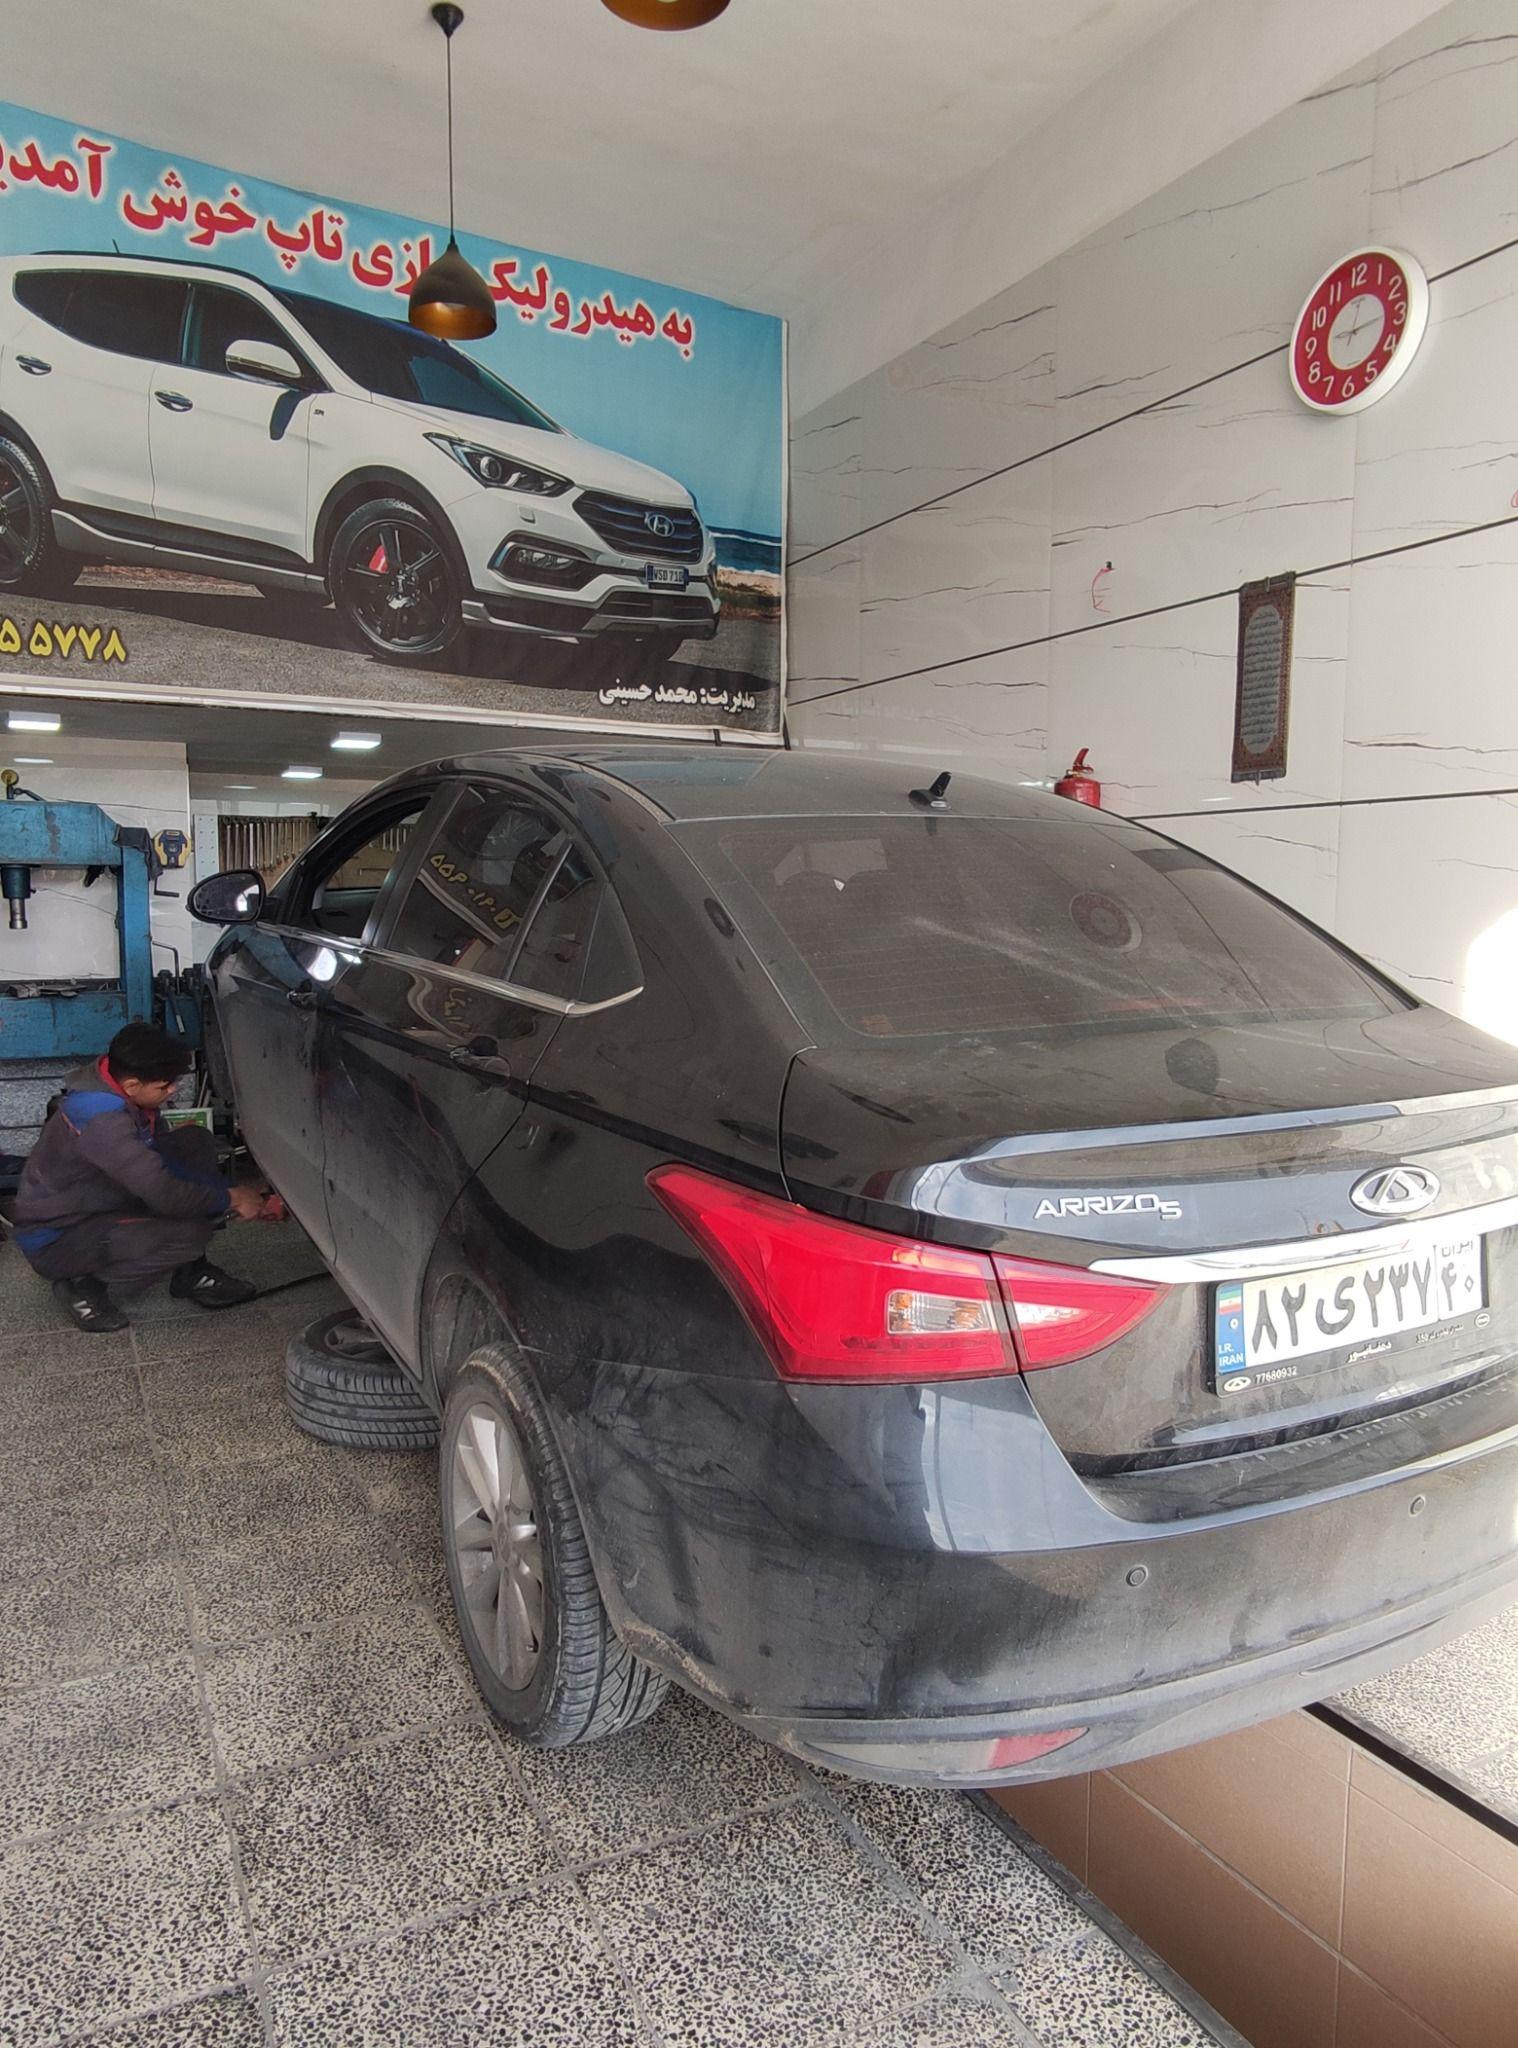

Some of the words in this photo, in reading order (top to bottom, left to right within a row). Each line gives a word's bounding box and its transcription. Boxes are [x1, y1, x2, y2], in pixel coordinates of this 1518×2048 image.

[0, 137, 112, 199] آمد
[123, 171, 257, 246] خوش
[266, 210, 344, 269] تاپ
[352, 237, 432, 297] ازی
[1351, 262, 1368, 288] 12
[1377, 263, 1383, 286] 1
[1329, 281, 1342, 306] 11
[1388, 275, 1402, 301] 2
[1312, 306, 1327, 331] 10
[1392, 301, 1407, 326] 3
[662, 311, 693, 358] به
[1382, 333, 1397, 353] 4
[1305, 336, 1318, 360] 9
[1308, 360, 1321, 384] 8
[1364, 359, 1378, 384] 5
[1322, 375, 1335, 398] 7
[1342, 375, 1355, 398] 6
[599, 677, 653, 705] حسینی
[654, 684, 698, 705] محمد
[1218, 1353, 1244, 1367] IRAN
